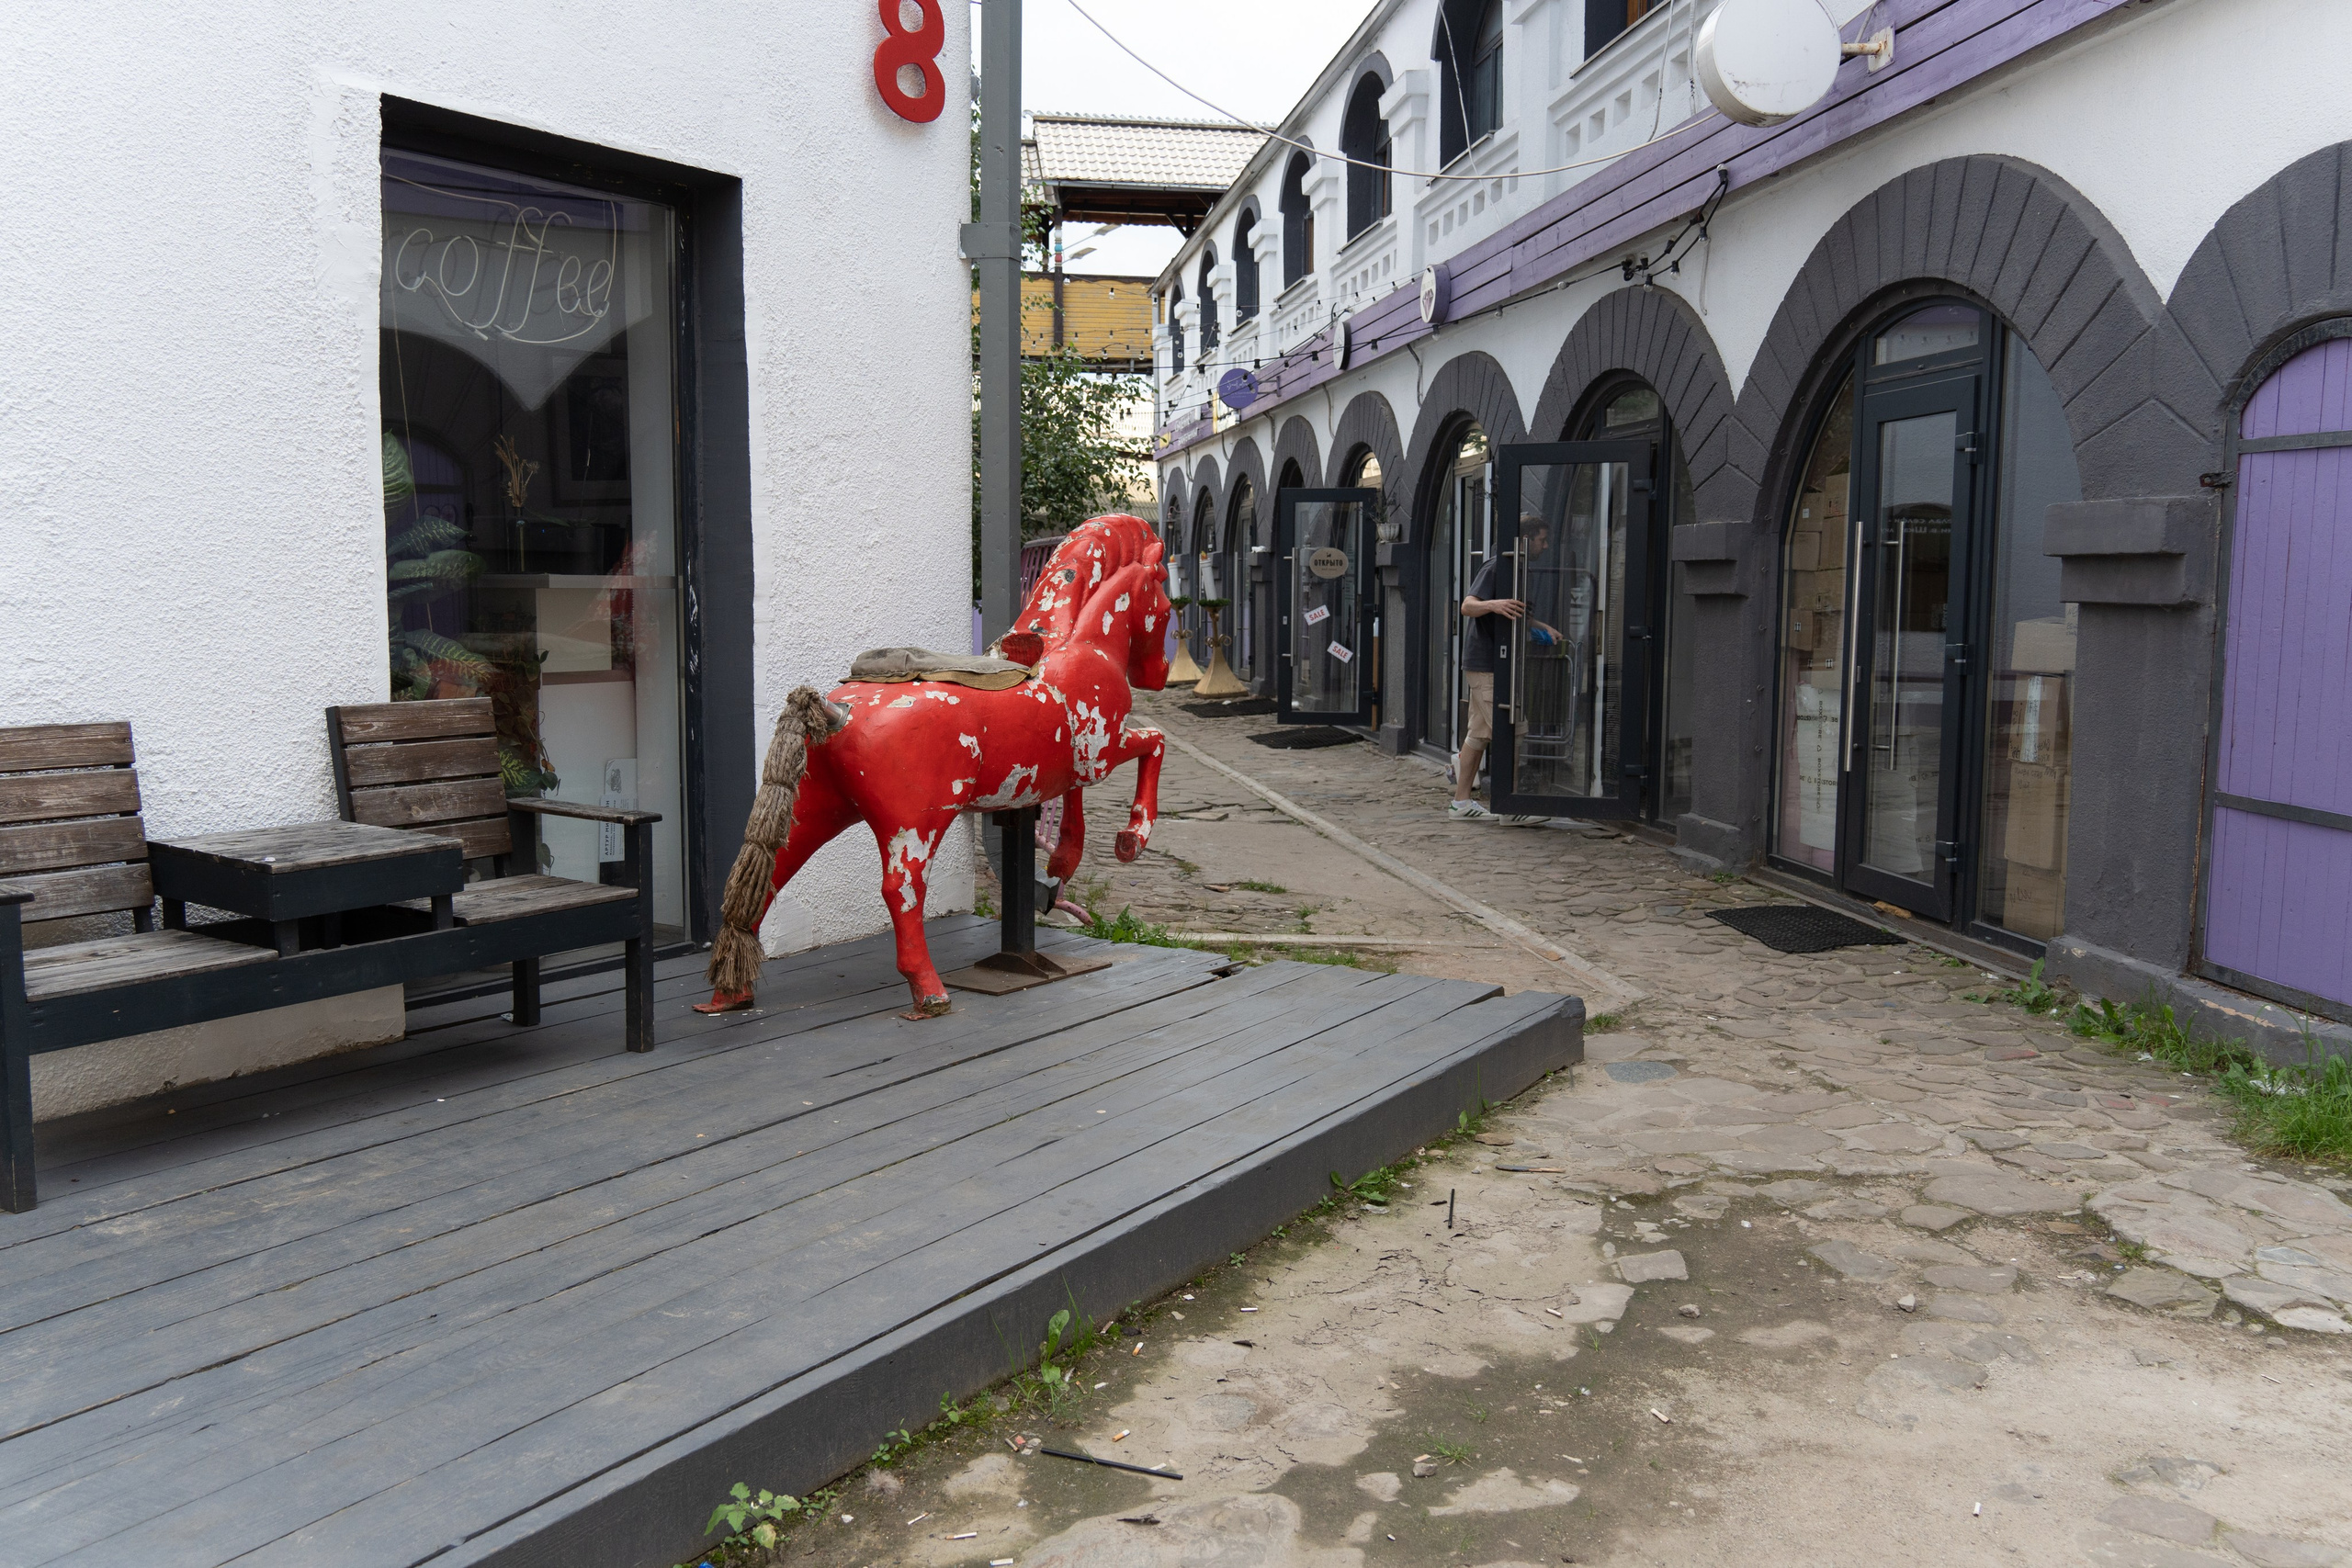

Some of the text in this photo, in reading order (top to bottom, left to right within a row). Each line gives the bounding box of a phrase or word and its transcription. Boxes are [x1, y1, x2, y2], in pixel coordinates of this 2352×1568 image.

[873, 0, 946, 124] 8
[395, 206, 612, 334] coffee
[1309, 609, 1325, 621] SALE
[1332, 646, 1348, 659] SALE
